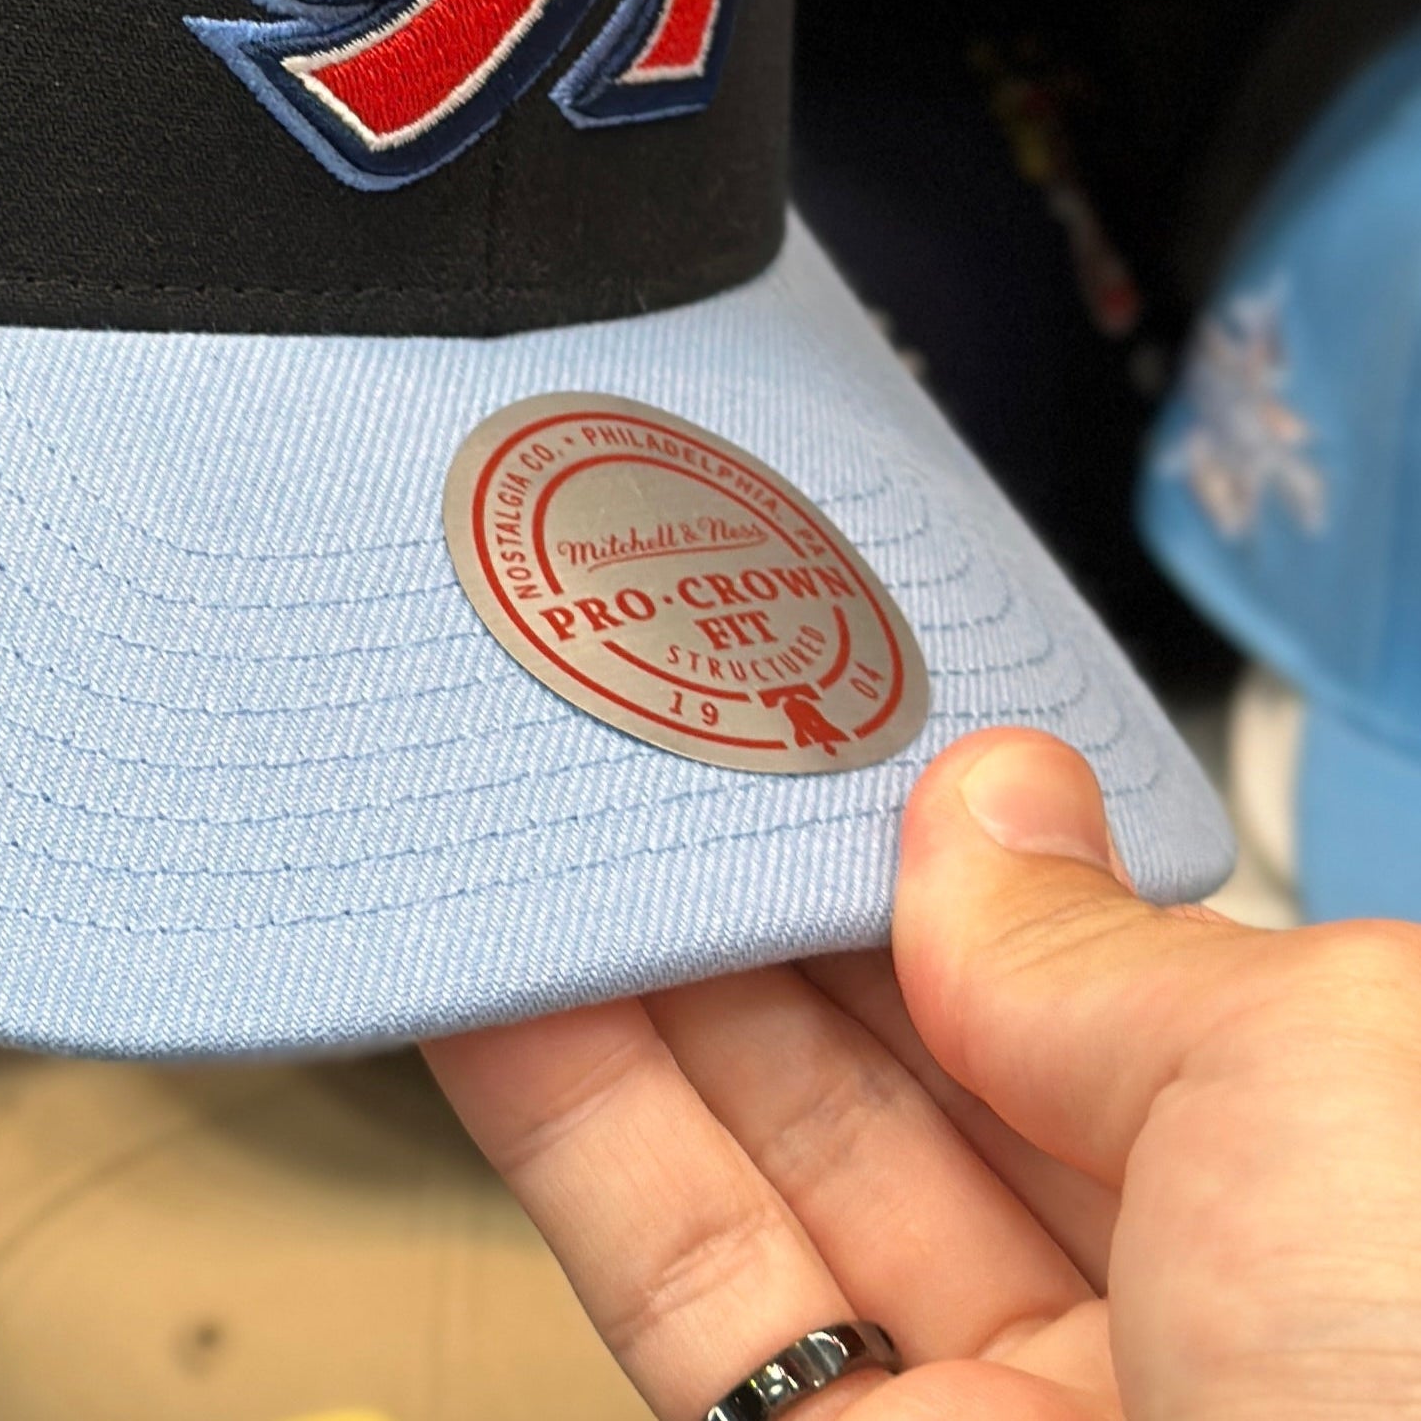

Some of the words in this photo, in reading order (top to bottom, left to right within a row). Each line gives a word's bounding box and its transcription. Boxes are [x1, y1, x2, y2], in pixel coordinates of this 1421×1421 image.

[494, 472, 543, 600] NOSTALGIA
[556, 522, 676, 567] Mitchell
[679, 523, 702, 544] &
[697, 515, 765, 544] Ness
[666, 624, 826, 681] STRUCTURED
[694, 610, 780, 651] FIT
[668, 690, 719, 726] 19
